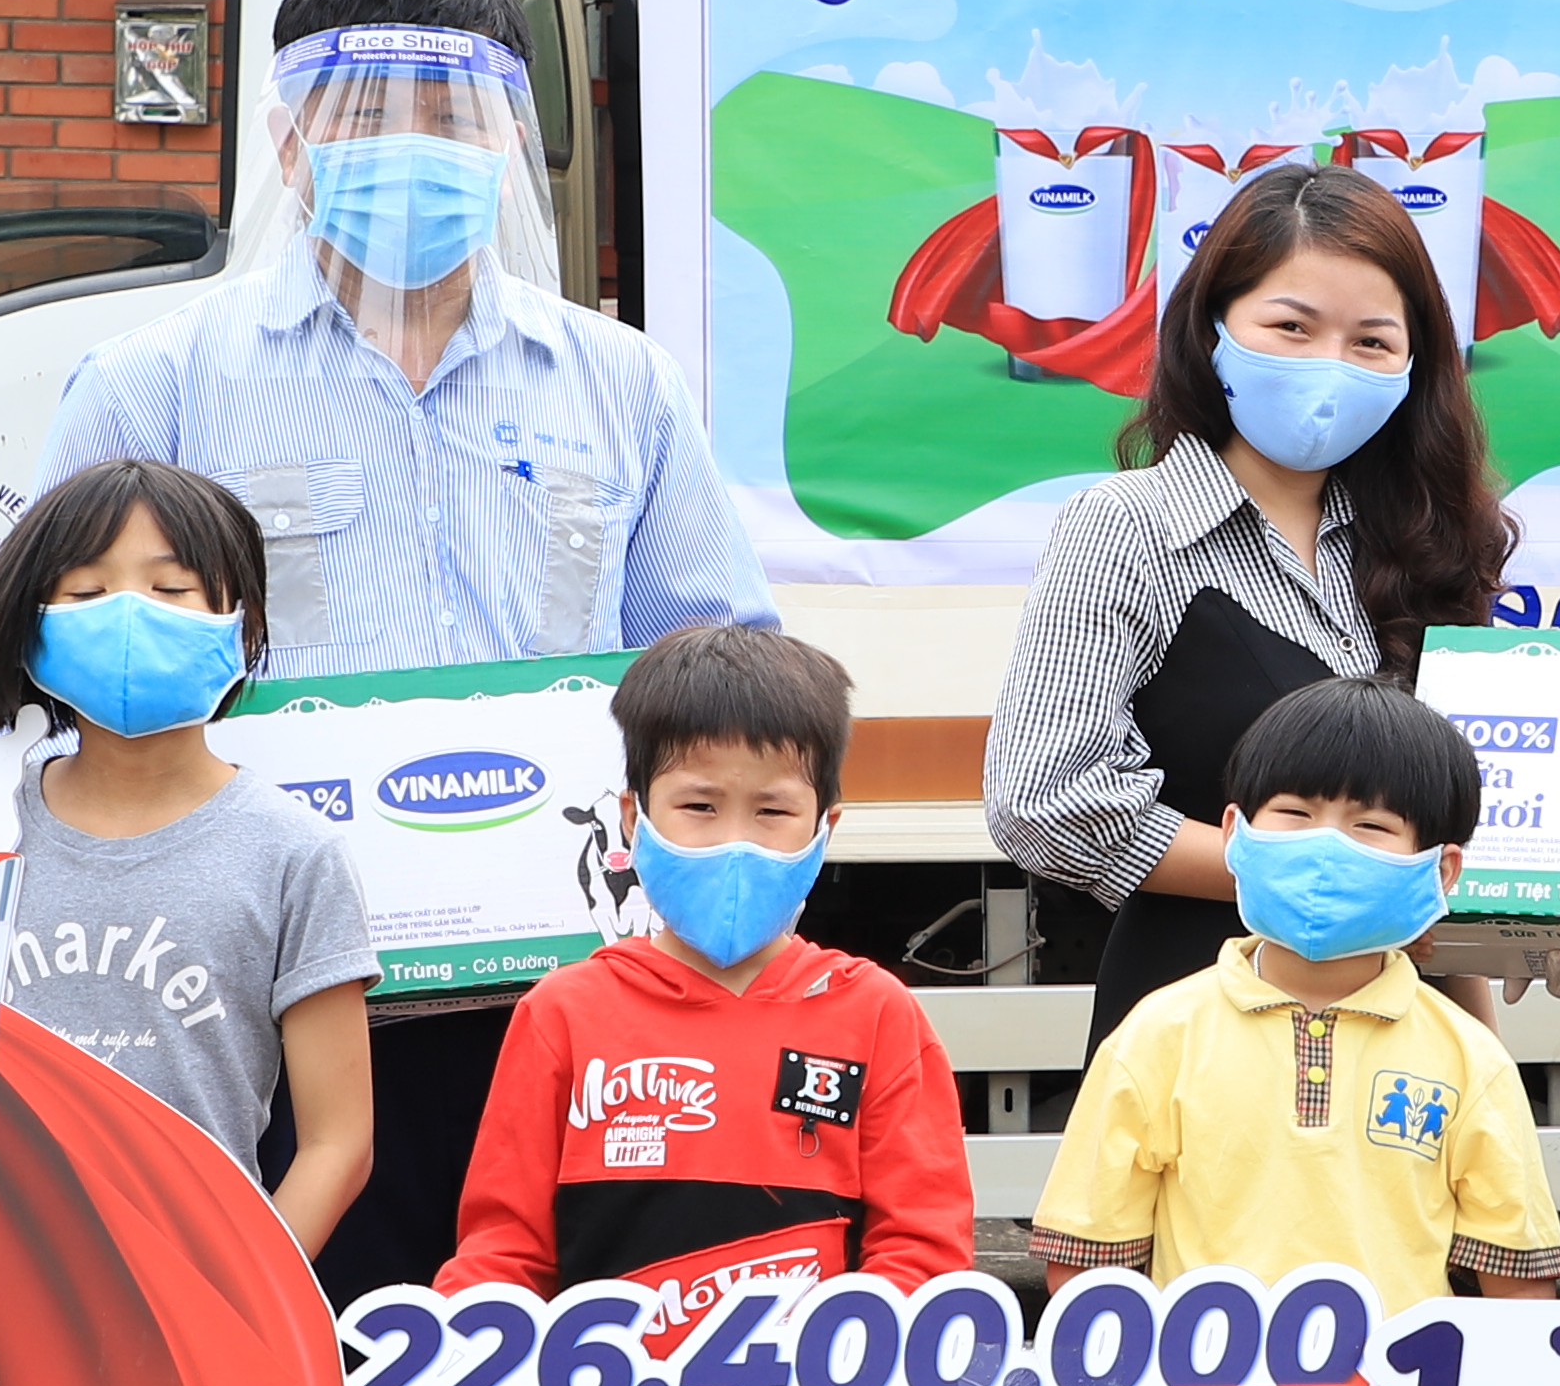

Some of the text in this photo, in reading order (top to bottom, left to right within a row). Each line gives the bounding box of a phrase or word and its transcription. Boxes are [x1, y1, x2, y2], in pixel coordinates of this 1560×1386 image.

[343, 34, 469, 54] Face Shield
[352, 52, 460, 65] Protective Isolation Mask
[1033, 192, 1092, 205] VINAMILK
[1453, 720, 1552, 749] 100%
[387, 766, 538, 804] VINAMILK
[1476, 794, 1545, 829] ươi
[1466, 880, 1509, 899] Tươi
[1515, 881, 1552, 904] Tiệt
[390, 954, 559, 982] Trùng Có Đường
[612, 1111, 661, 1126] Anyway
